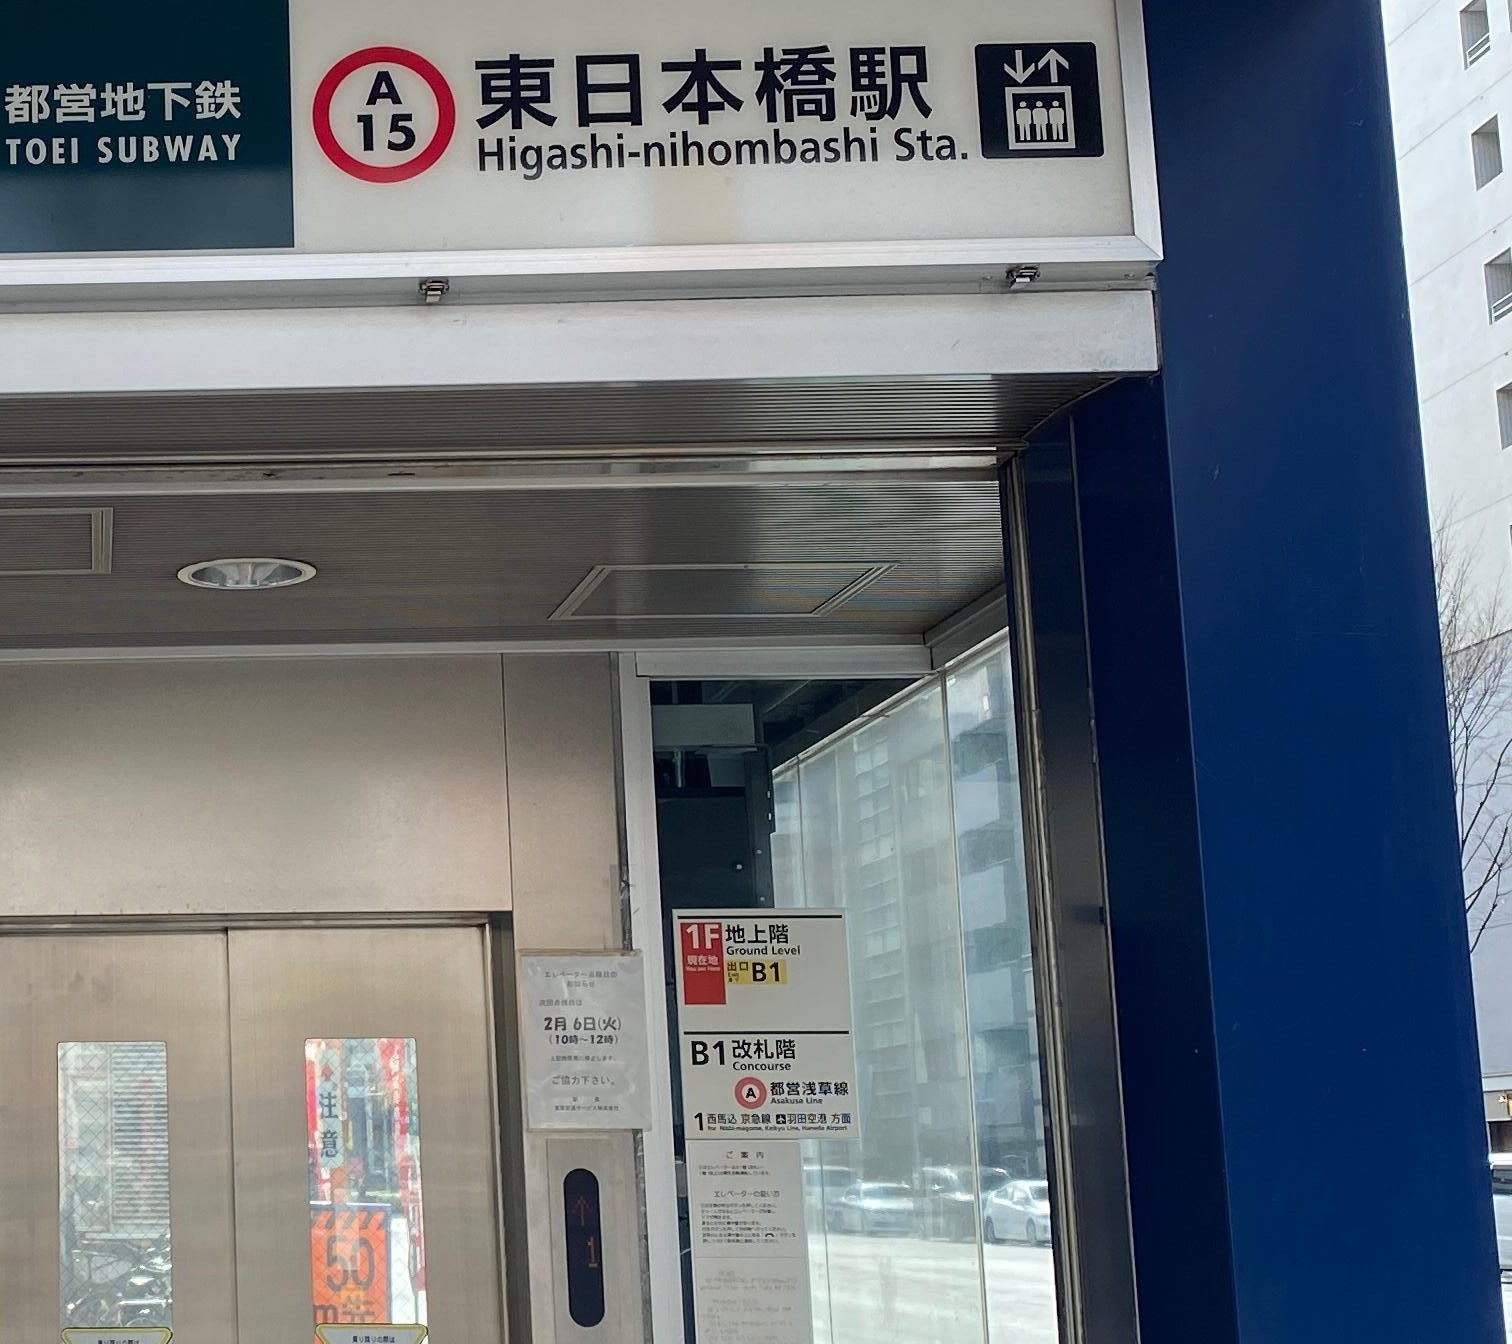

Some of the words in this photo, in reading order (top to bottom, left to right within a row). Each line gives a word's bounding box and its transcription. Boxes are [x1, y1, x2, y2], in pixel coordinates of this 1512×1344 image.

[365, 71, 402, 105] A
[474, 45, 932, 129] 東日本橋駅
[4, 79, 242, 124] 都営地下鉄
[355, 110, 417, 153] 15
[5, 136, 80, 166] TOEI
[98, 133, 242, 164] SUBWAY
[477, 126, 880, 182] Higashi-nihombashi
[894, 126, 970, 163] Sta.
[686, 924, 719, 949] 1F
[725, 924, 789, 944] 地上階
[687, 956, 719, 966] 現在地
[726, 946, 768, 955] Ground
[772, 945, 801, 955] Level
[727, 961, 749, 971] 出口
[752, 962, 780, 982] B1
[691, 1040, 725, 1066] B1
[732, 1039, 795, 1060] 改札階
[733, 1061, 791, 1071] Concourse
[745, 1087, 756, 1098] A
[770, 1081, 849, 1096] 都営浅草線
[319, 1091, 338, 1158] 注意
[694, 1113, 704, 1131] 1
[707, 1113, 737, 1124] 西馬込
[741, 1113, 771, 1124] 京急線
[788, 1113, 827, 1124] 羽田空港
[831, 1113, 851, 1124] 方面
[326, 1235, 375, 1292] 50
